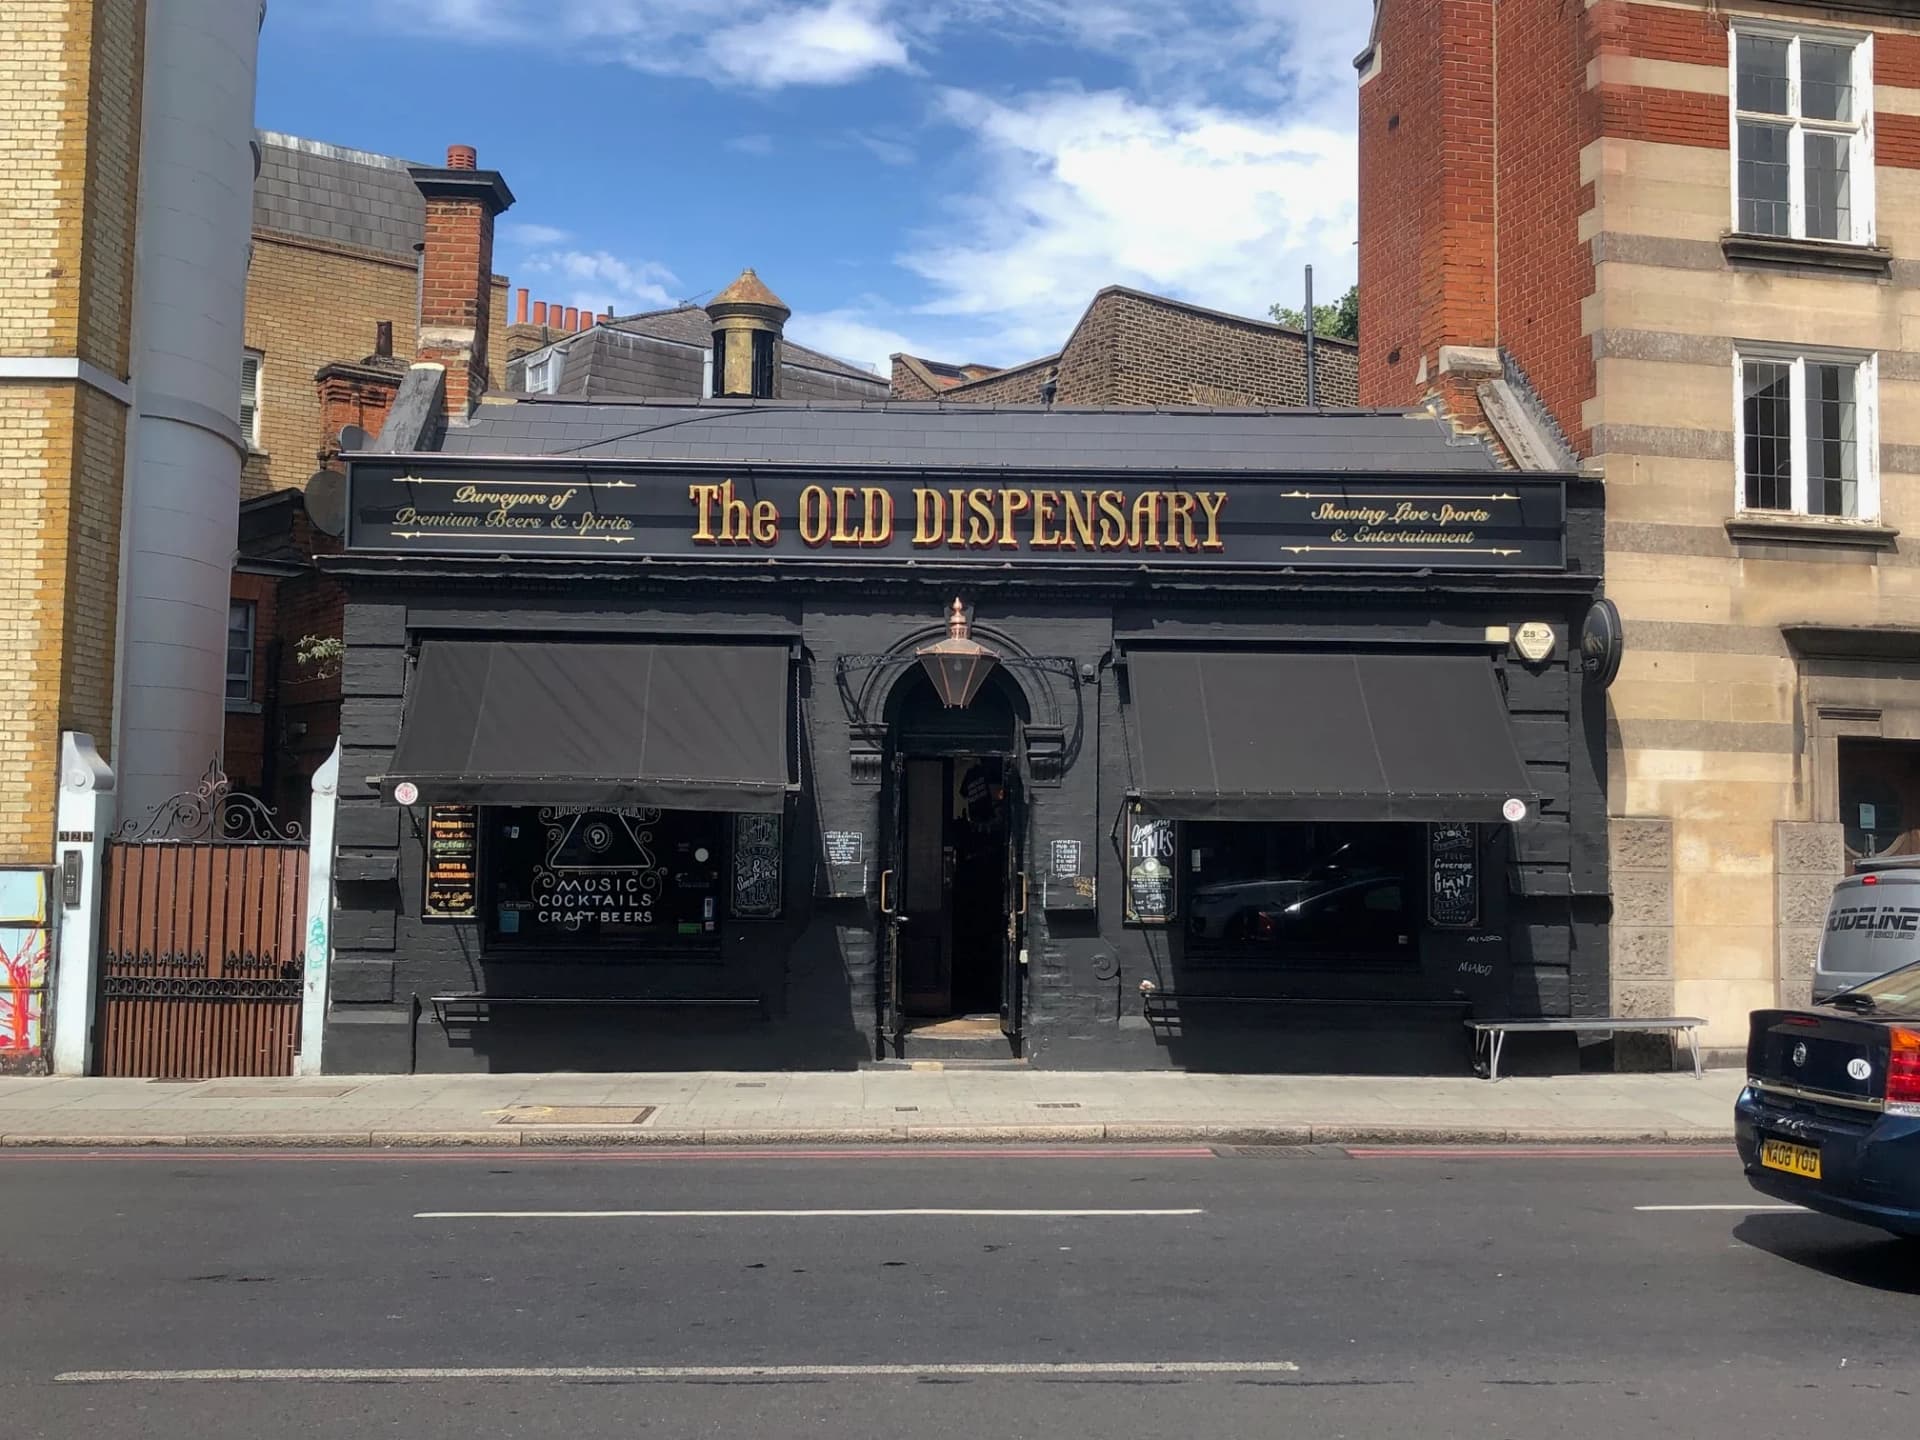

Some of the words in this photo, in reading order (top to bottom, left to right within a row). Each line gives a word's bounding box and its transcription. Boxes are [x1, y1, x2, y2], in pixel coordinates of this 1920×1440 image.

[452, 486, 547, 509] Purveyors
[549, 487, 577, 510] of
[394, 507, 479, 528] Premium
[484, 508, 541, 530] Beers
[552, 514, 568, 529] &
[574, 511, 633, 534] Spirits
[689, 479, 780, 547] The
[797, 485, 895, 548] OLD
[911, 488, 1226, 552] DISPENSARY
[1311, 503, 1388, 524] Showing
[1388, 503, 1430, 525] Live
[1432, 503, 1490, 525] Sports
[1330, 528, 1347, 542] &
[1353, 526, 1474, 544] Entertainment
[1130, 829, 1174, 858] TIMES
[1433, 829, 1471, 842] SPORT
[1434, 857, 1473, 871] Coverage
[556, 878, 638, 892] MUSIC
[1434, 871, 1474, 893] GIANT
[539, 893, 653, 907] COCKTAILS
[600, 910, 653, 923] BEERS
[1851, 1062, 1865, 1077] UK
